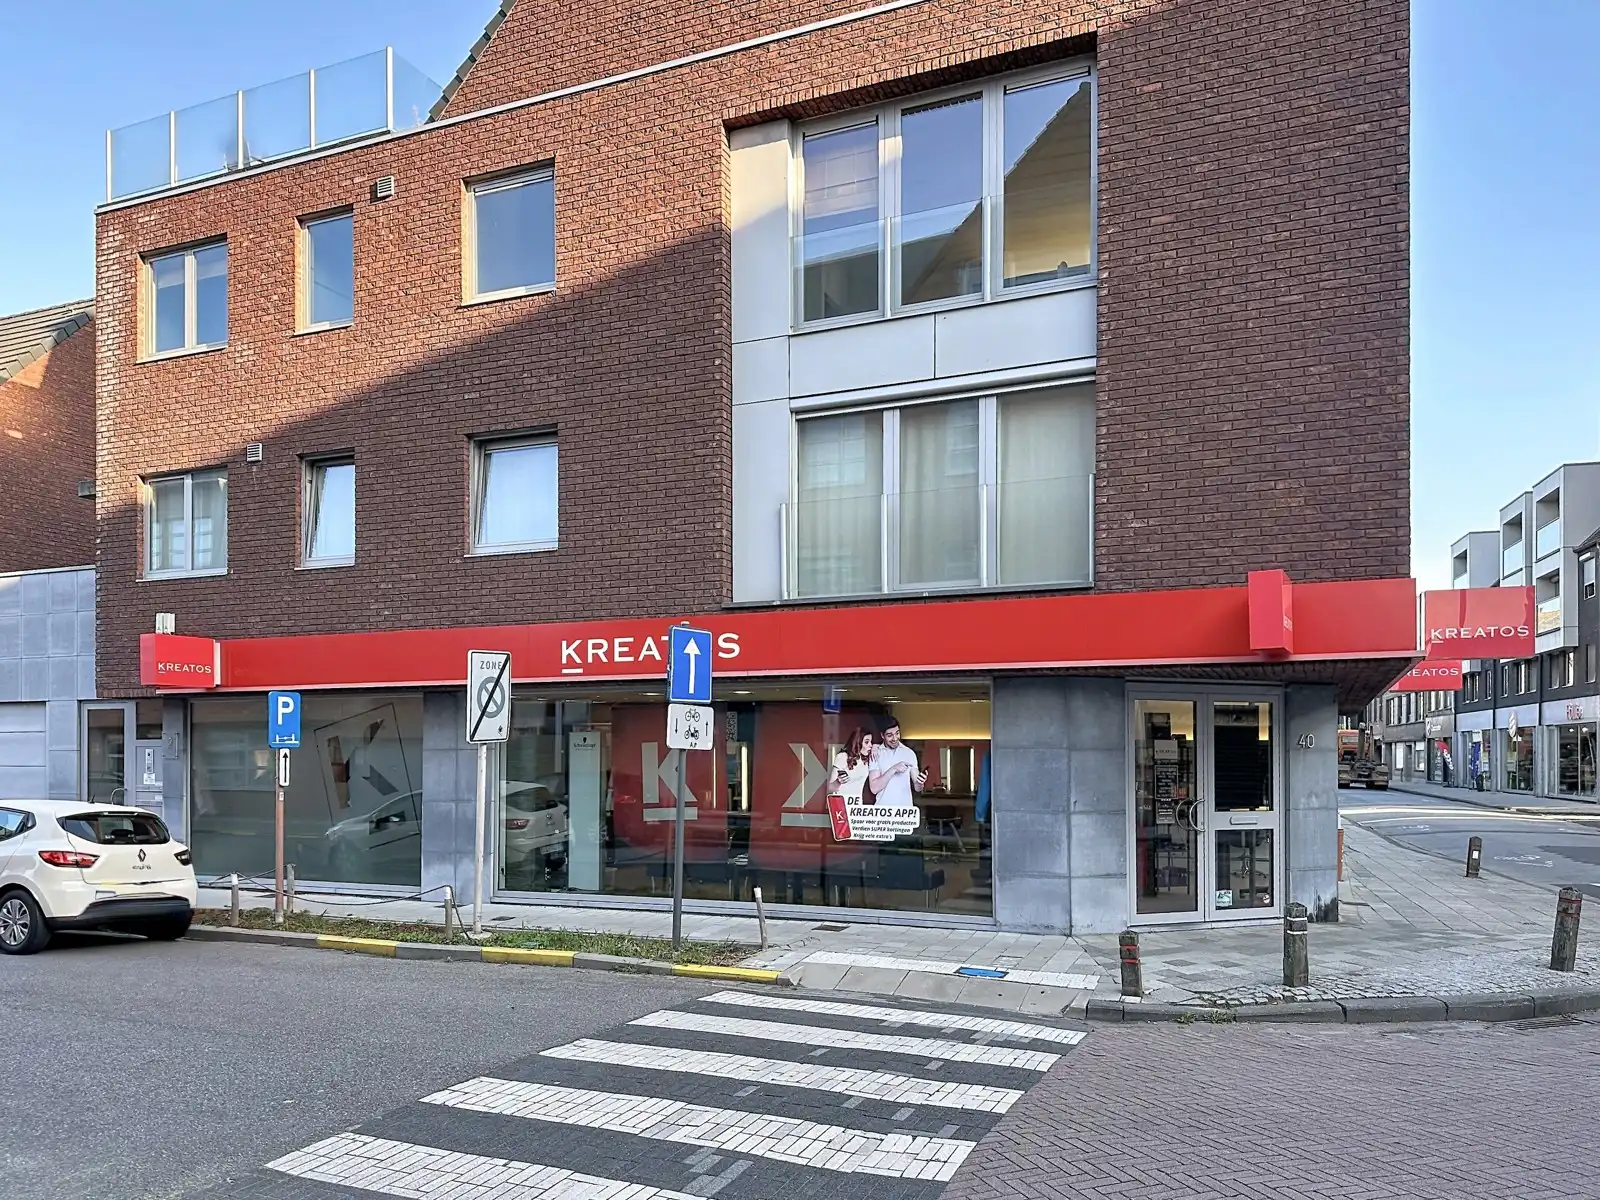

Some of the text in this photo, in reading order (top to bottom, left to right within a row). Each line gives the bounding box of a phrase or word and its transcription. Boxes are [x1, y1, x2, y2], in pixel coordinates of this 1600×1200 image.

[1431, 625, 1530, 643] KREATOS
[561, 632, 741, 673] KREAS
[157, 662, 212, 674] KREATOS
[480, 660, 502, 670] ZONE
[277, 696, 294, 725] P
[1299, 733, 1315, 748] 40
[641, 741, 698, 821] K
[847, 796, 860, 805] DE
[836, 810, 845, 823] K
[850, 807, 917, 818] KREATOS APP!
